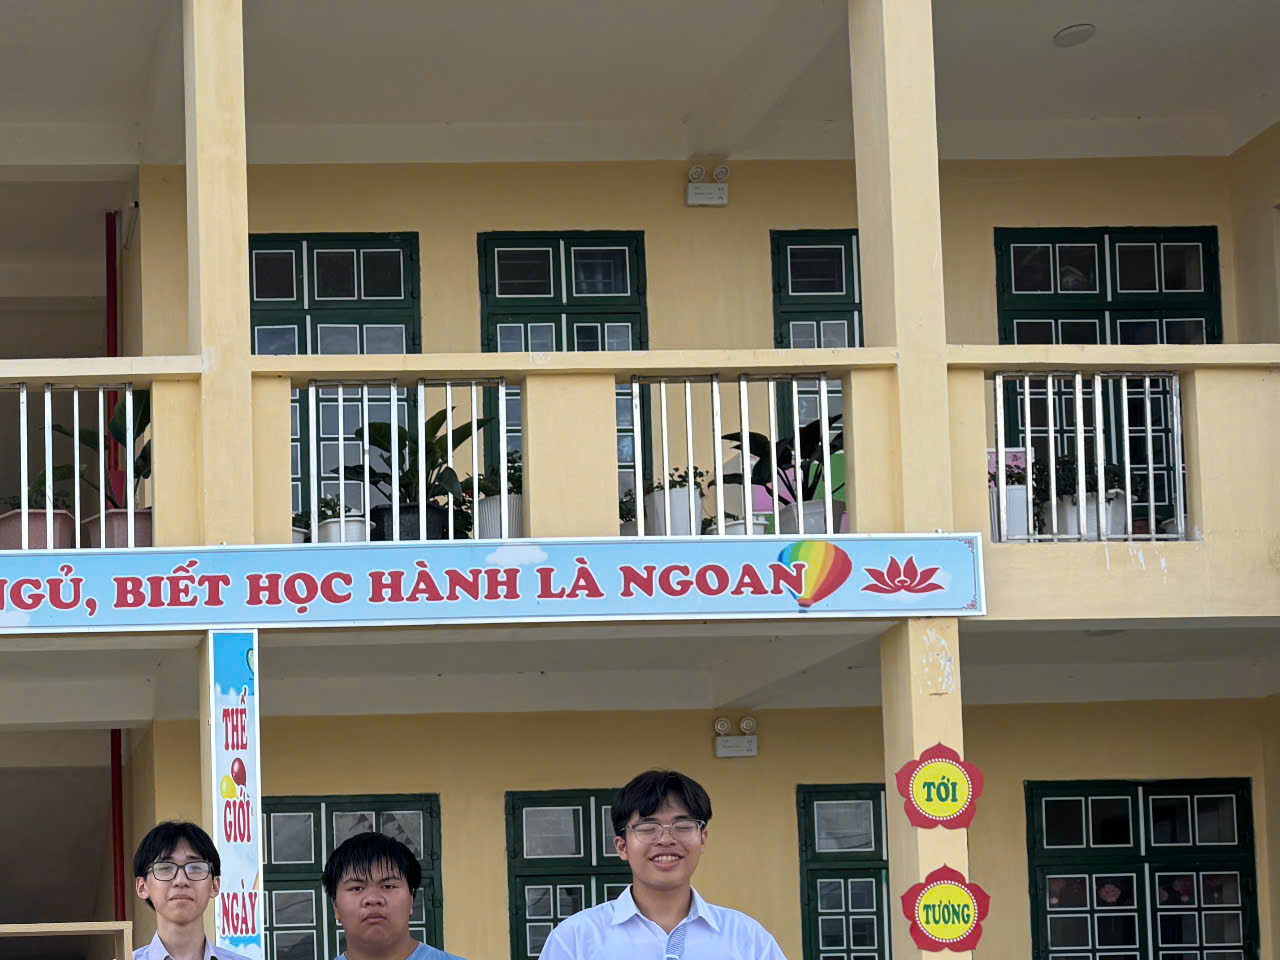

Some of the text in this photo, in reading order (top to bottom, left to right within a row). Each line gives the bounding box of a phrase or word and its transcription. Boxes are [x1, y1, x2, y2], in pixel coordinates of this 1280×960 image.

[113, 560, 231, 608] BIẾT
[246, 572, 352, 614] HỌC
[368, 560, 523, 603] HÀNH
[536, 557, 601, 600] LÀ
[620, 561, 807, 598] NGOAN
[222, 687, 248, 751] THẾ
[922, 776, 958, 802] TỚI
[224, 792, 252, 843] GIỚI
[220, 879, 258, 936] NGÀY
[923, 900, 971, 925] TƯƠNG
